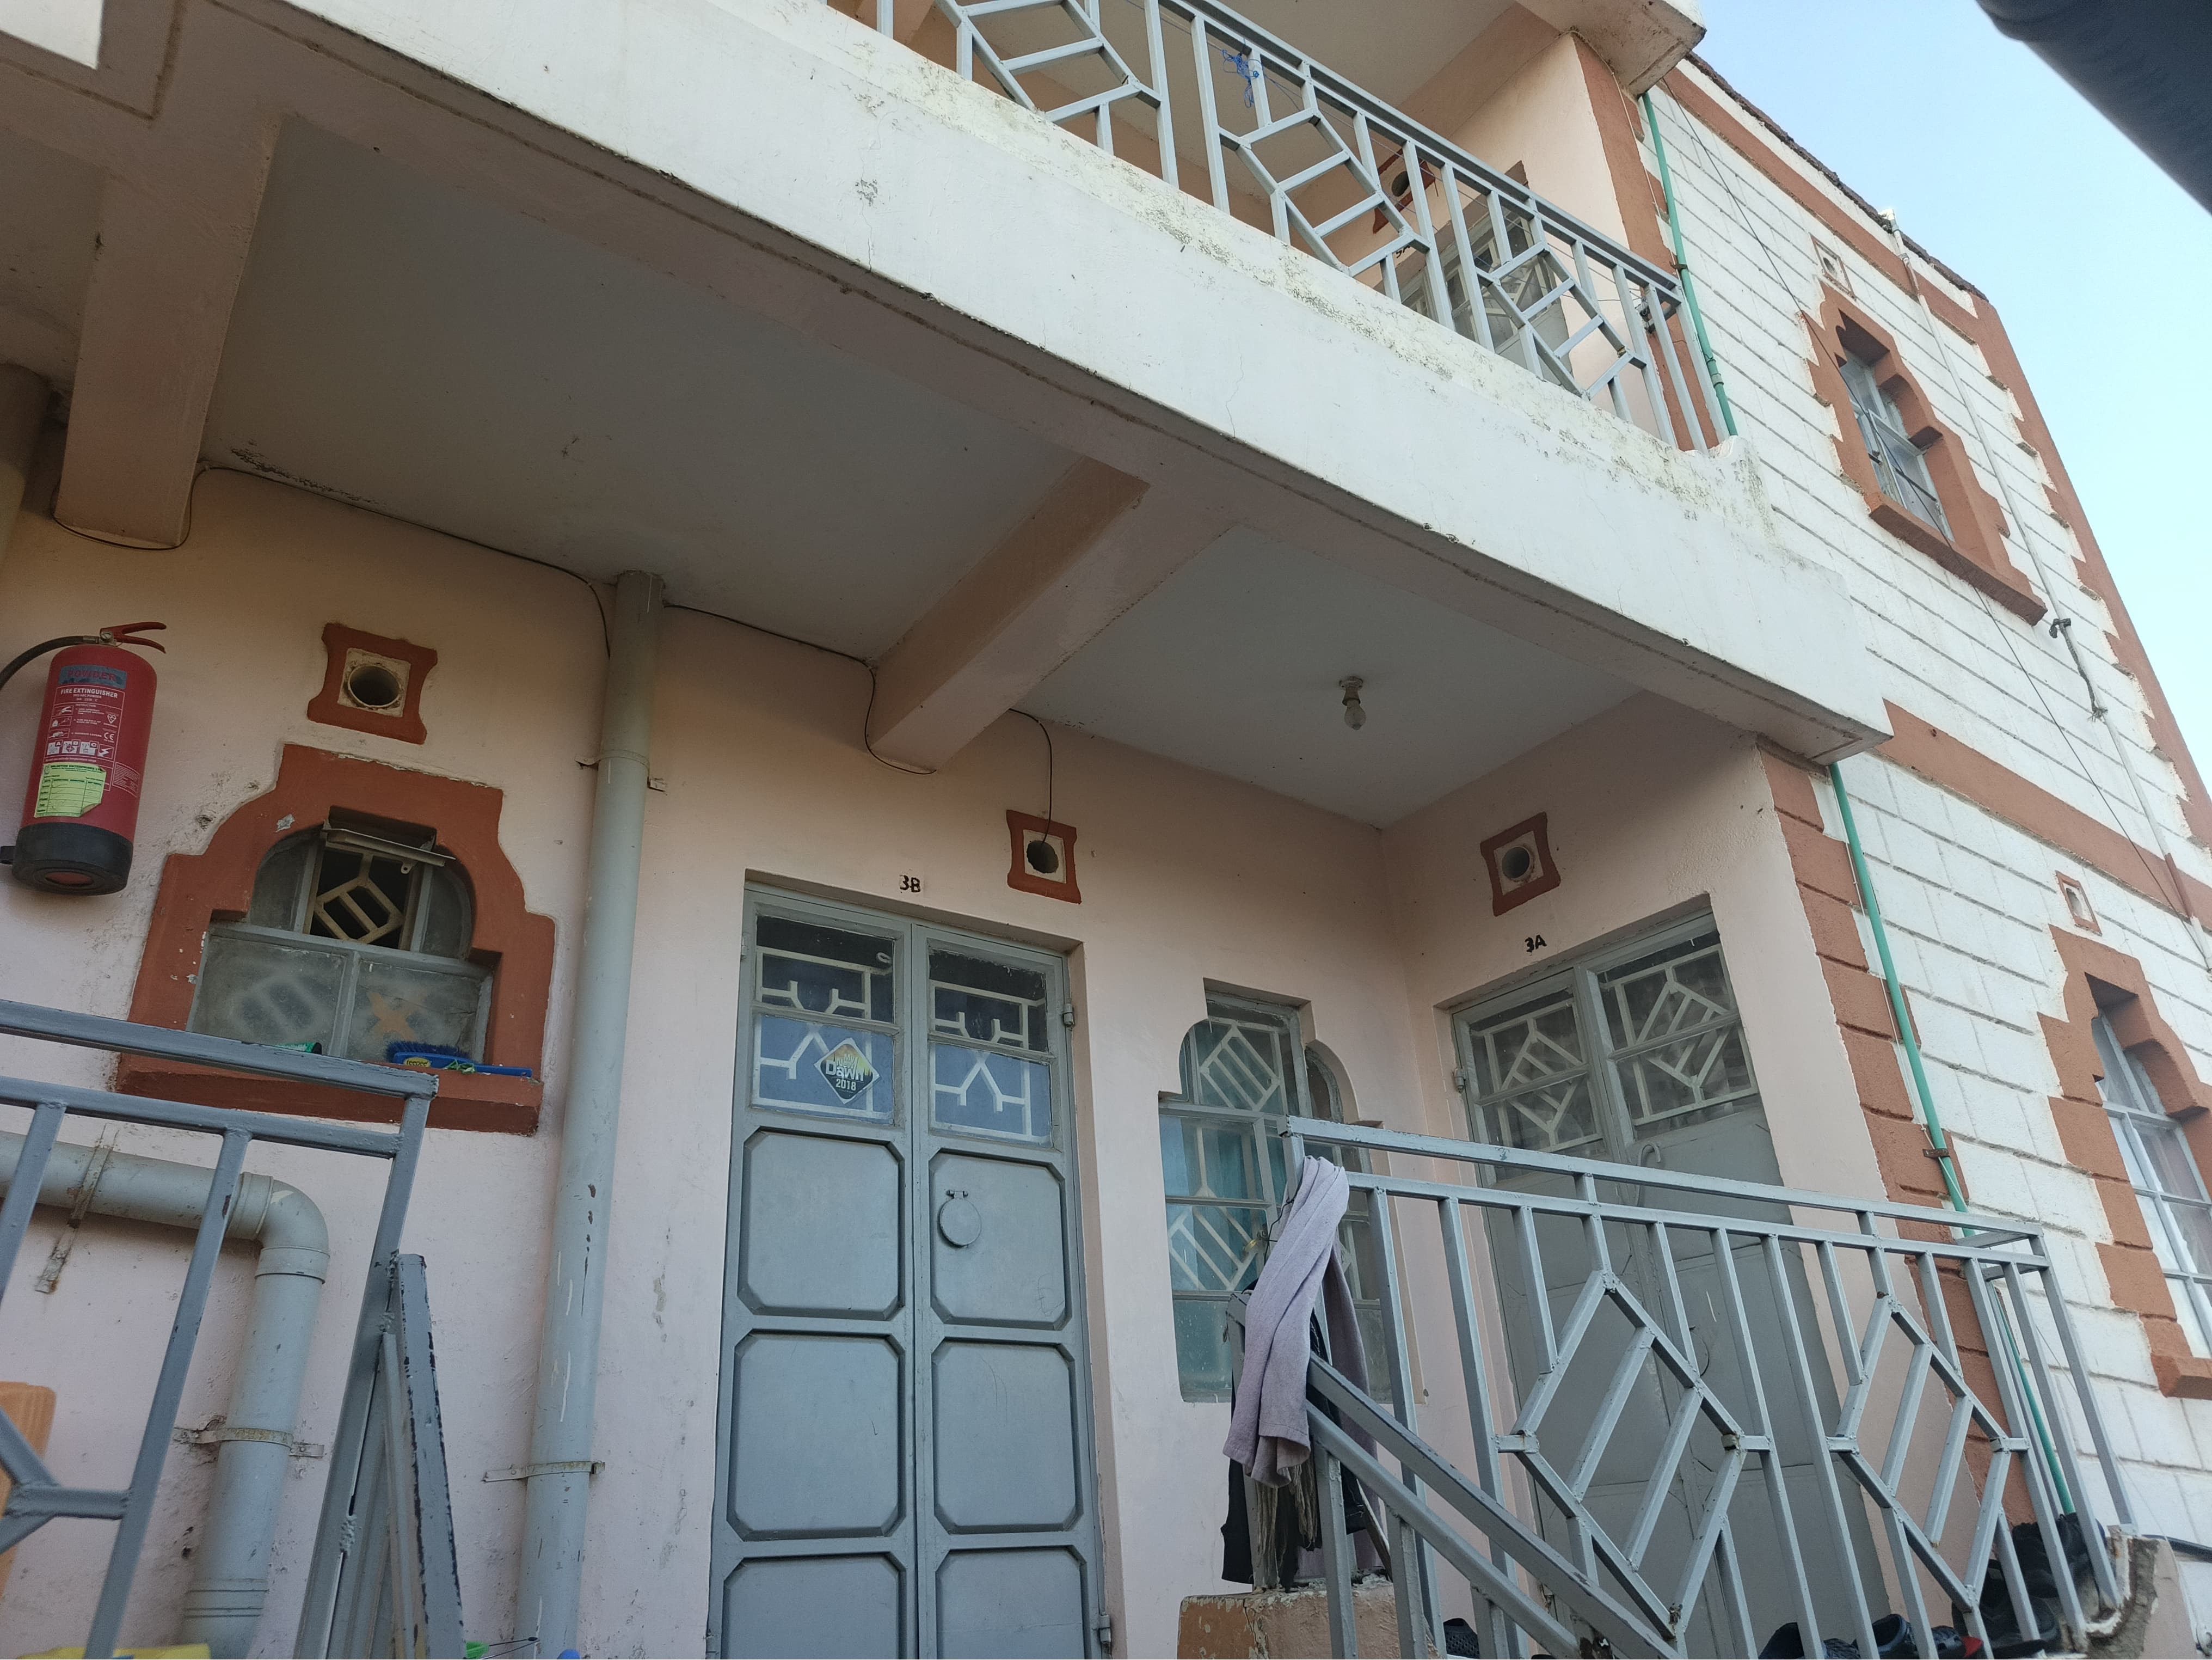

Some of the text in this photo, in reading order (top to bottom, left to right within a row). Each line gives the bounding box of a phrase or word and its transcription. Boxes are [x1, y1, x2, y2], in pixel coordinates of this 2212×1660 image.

[67, 670, 116, 681] POWDER
[73, 688, 118, 698] EXTINGUISHER
[899, 874, 921, 893] 3B
[1525, 934, 1547, 953] 3A
[835, 1079, 856, 1091] 2018
